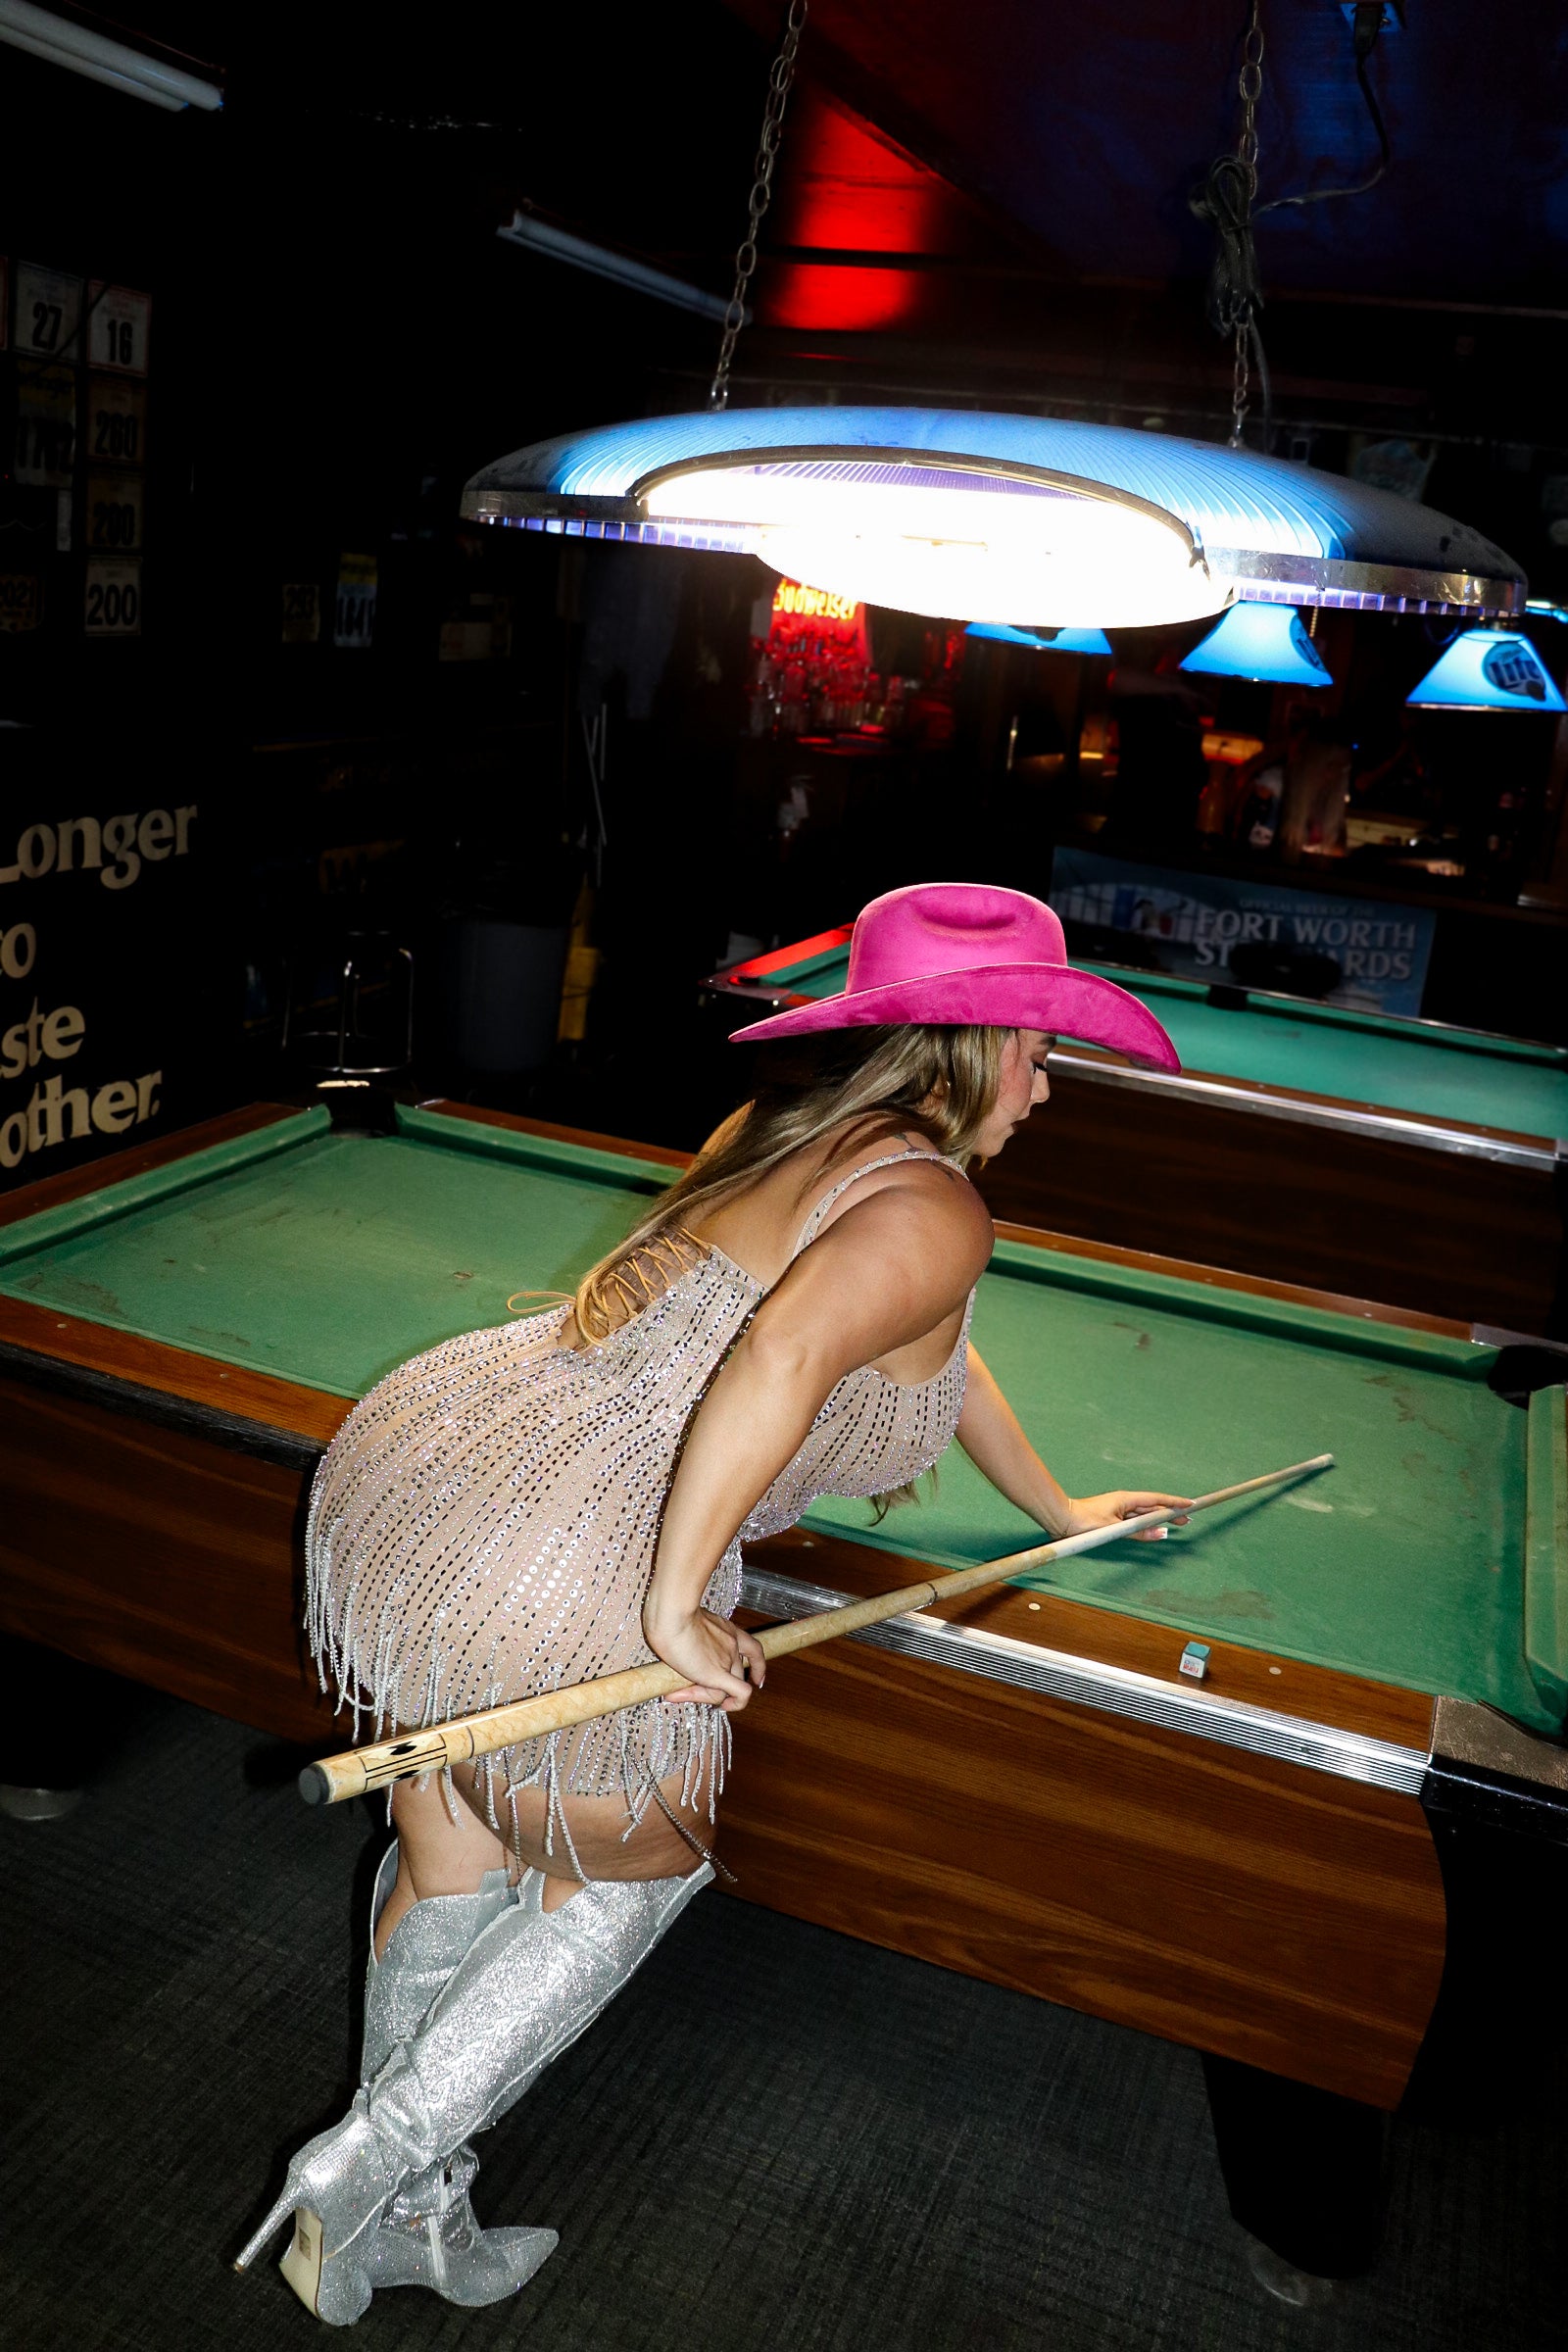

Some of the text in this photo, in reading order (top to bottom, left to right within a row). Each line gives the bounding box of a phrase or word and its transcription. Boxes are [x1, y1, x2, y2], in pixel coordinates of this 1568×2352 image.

[32, 302, 62, 350] 27
[108, 319, 132, 365] 16
[87, 585, 135, 625] 200
[1196, 907, 1416, 951] FORT WORTH
